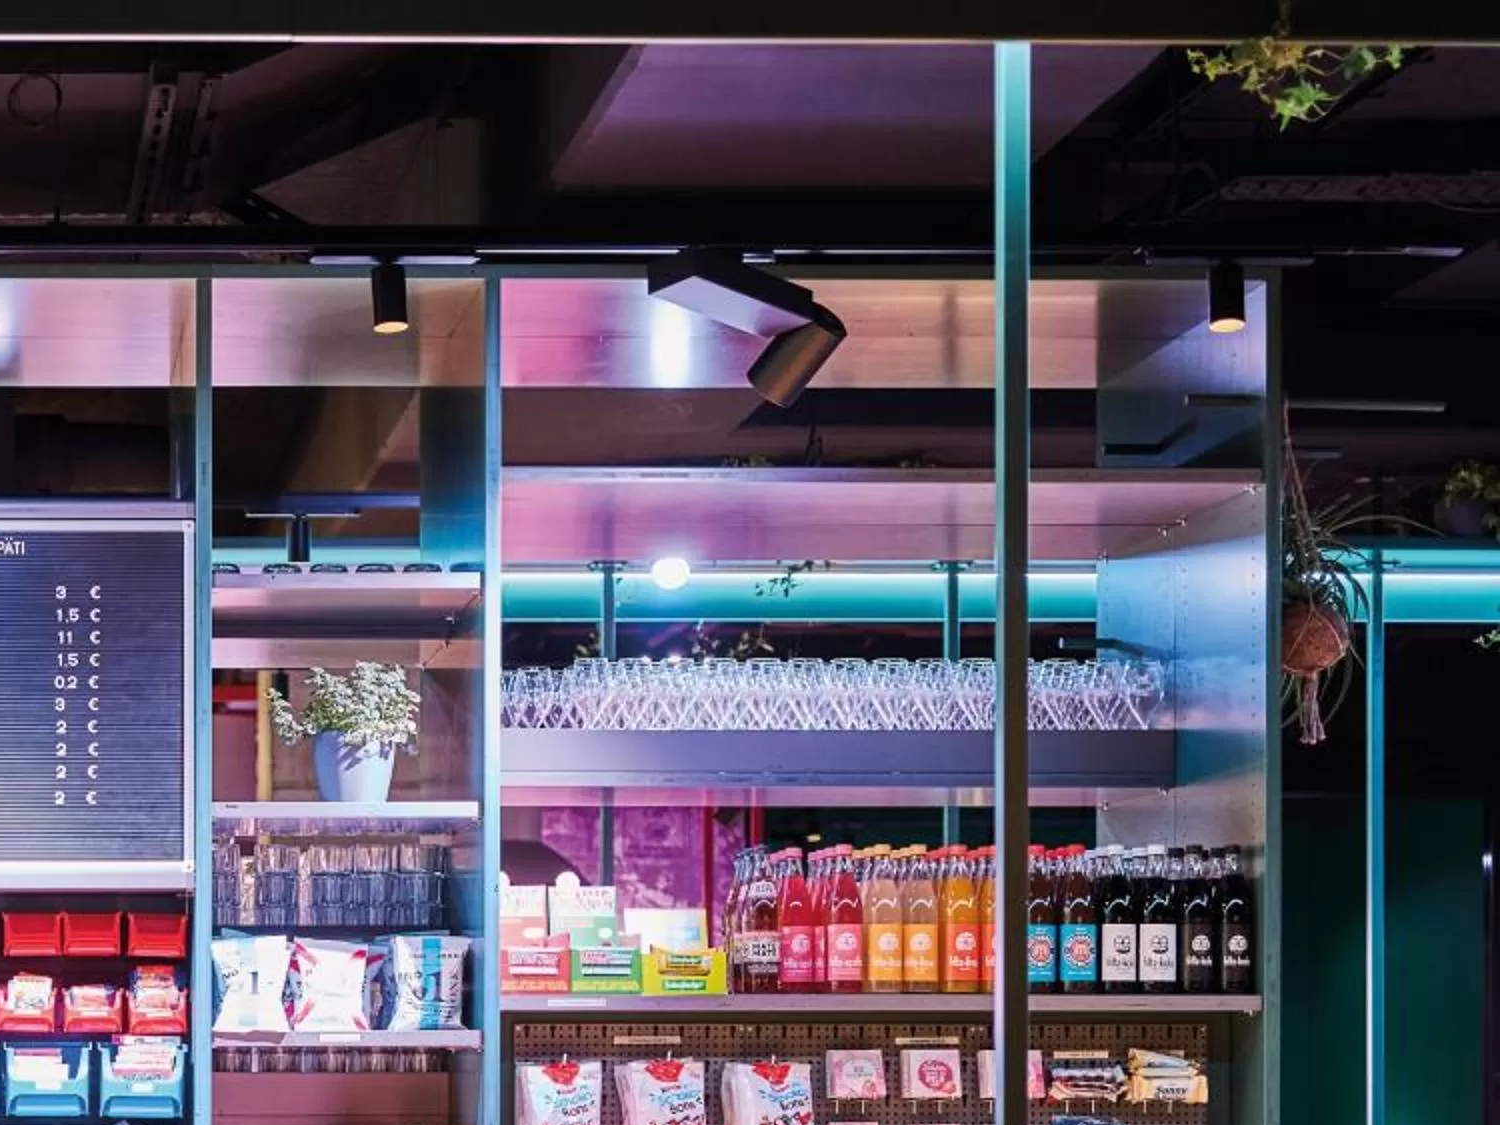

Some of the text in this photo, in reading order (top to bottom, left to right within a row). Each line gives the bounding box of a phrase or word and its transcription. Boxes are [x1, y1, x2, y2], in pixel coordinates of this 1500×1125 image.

[55, 585, 67, 600] 3
[57, 630, 73, 645] 11
[54, 696, 66, 712] 3
[55, 719, 67, 734] 2
[55, 742, 67, 757] 2
[55, 764, 67, 779] 2
[54, 790, 66, 806] 2
